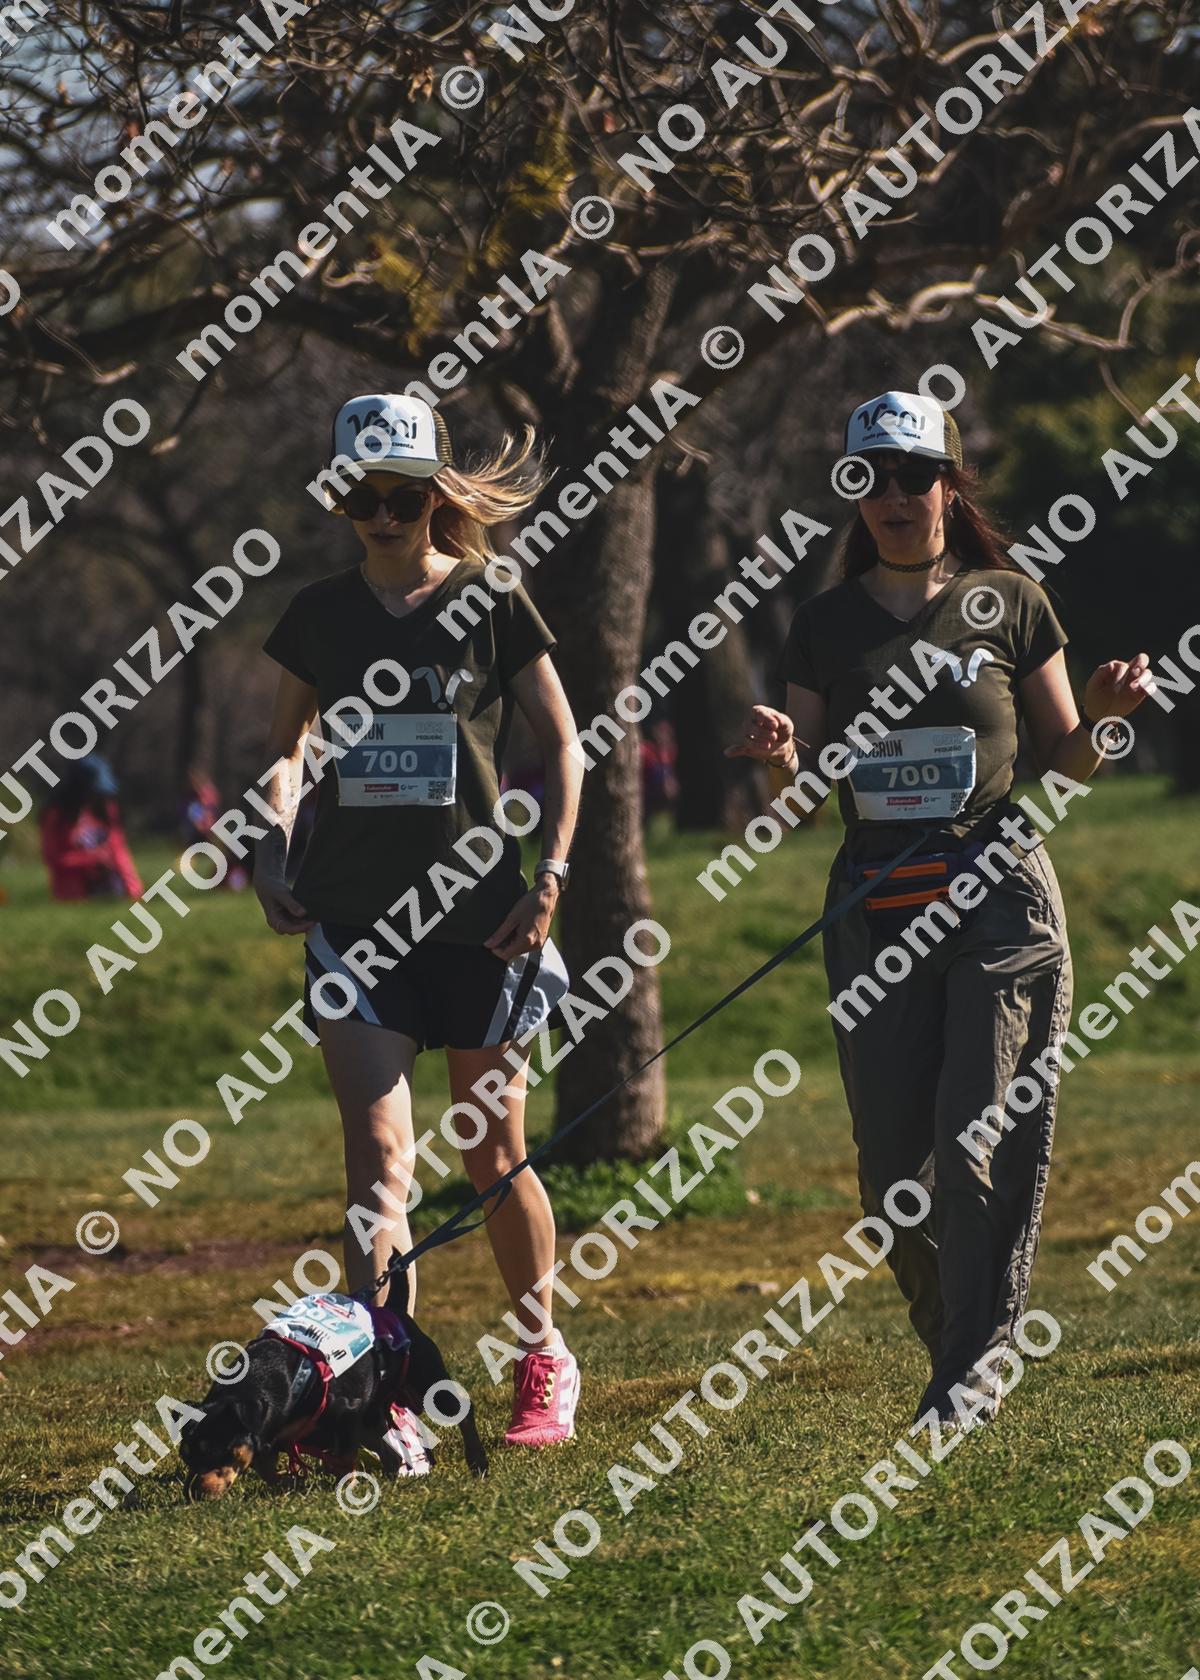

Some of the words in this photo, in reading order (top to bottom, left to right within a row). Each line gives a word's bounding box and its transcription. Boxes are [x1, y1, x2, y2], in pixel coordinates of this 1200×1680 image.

[857, 740, 903, 759] DGRUN
[362, 750, 418, 773] 700
[882, 764, 940, 788] 700
